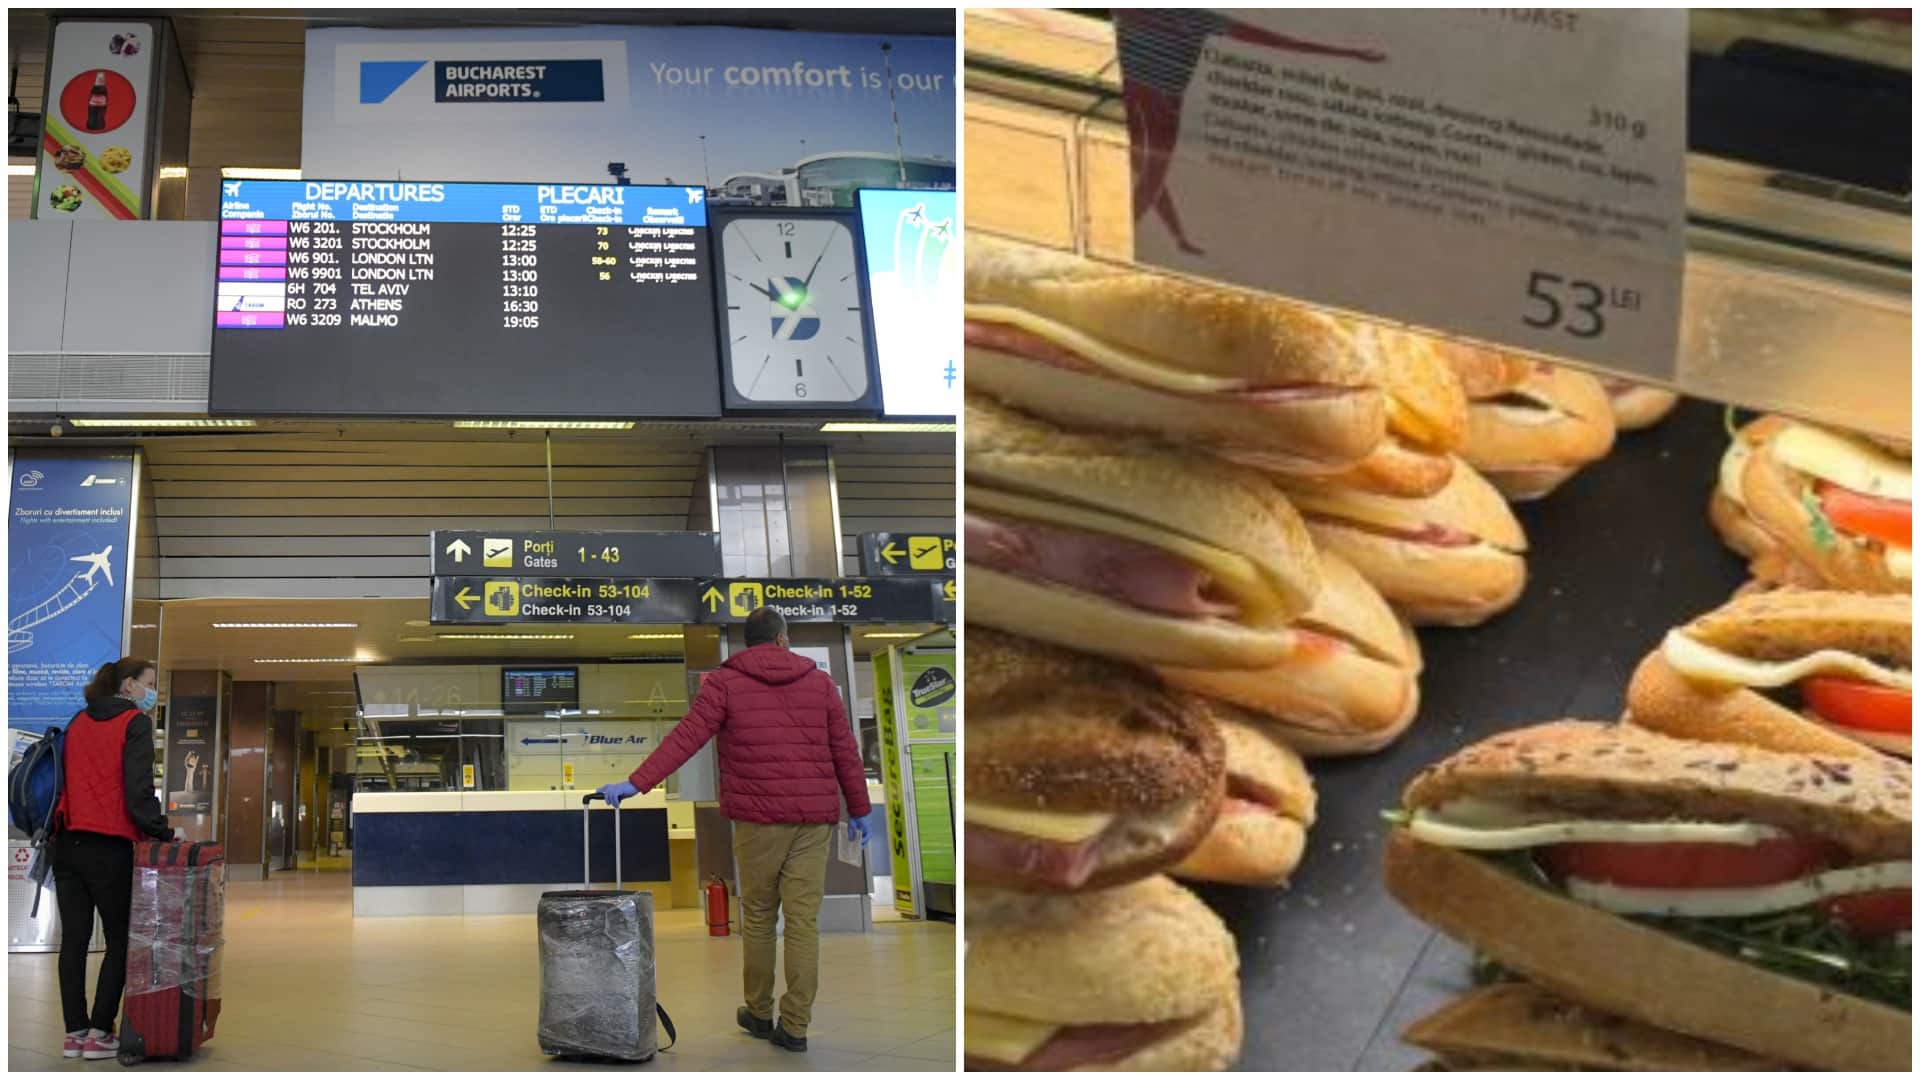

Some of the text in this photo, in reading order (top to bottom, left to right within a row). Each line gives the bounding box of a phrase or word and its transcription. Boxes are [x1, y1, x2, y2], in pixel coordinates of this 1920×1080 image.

[445, 65, 547, 81] BUCHAREST
[650, 61, 714, 86] Your
[724, 62, 852, 88] comfort
[861, 67, 882, 88] is
[897, 72, 943, 91] our
[1589, 106, 1628, 132] 310
[305, 182, 446, 203] DEPARTURES
[536, 185, 625, 206] PLECARI
[289, 222, 310, 234] W6
[351, 223, 431, 235] STOCKHOLM
[501, 224, 537, 237] 12:25
[596, 226, 609, 236] 73
[777, 222, 796, 237] 12
[289, 237, 310, 249] W6
[312, 238, 343, 250] 3201
[351, 239, 431, 250] STOCKHOLM
[501, 240, 537, 252] 12:25
[597, 241, 610, 251] 70
[288, 252, 309, 264] W6
[351, 253, 406, 265] LONDON
[409, 253, 434, 266] LTN
[501, 255, 538, 267] 13:00
[288, 268, 309, 279] W6
[311, 268, 343, 280] 9901
[351, 269, 406, 280] LONDON
[409, 269, 434, 281] LTN
[502, 270, 538, 282] 13:00
[599, 272, 611, 281] 56
[287, 283, 539, 297] 6H 704 TEL AVIV 13:10
[287, 299, 539, 313] RO 273 ATHENS 16:30
[1520, 268, 1642, 340] 53 LEI
[286, 314, 540, 328] W6 3209 MALMO 19:05
[795, 383, 808, 399] 6
[15, 507, 42, 517] Zboruri
[54, 507, 99, 516] divertisment
[523, 555, 558, 568] Gates
[577, 546, 586, 563] 1
[601, 546, 620, 563] 43
[521, 584, 650, 599] Check-in 53-104
[765, 584, 872, 599] Check-in 1-52
[521, 603, 632, 617] Check-in 53-104
[830, 604, 858, 616] 1-52
[589, 734, 648, 745] Blue Air
